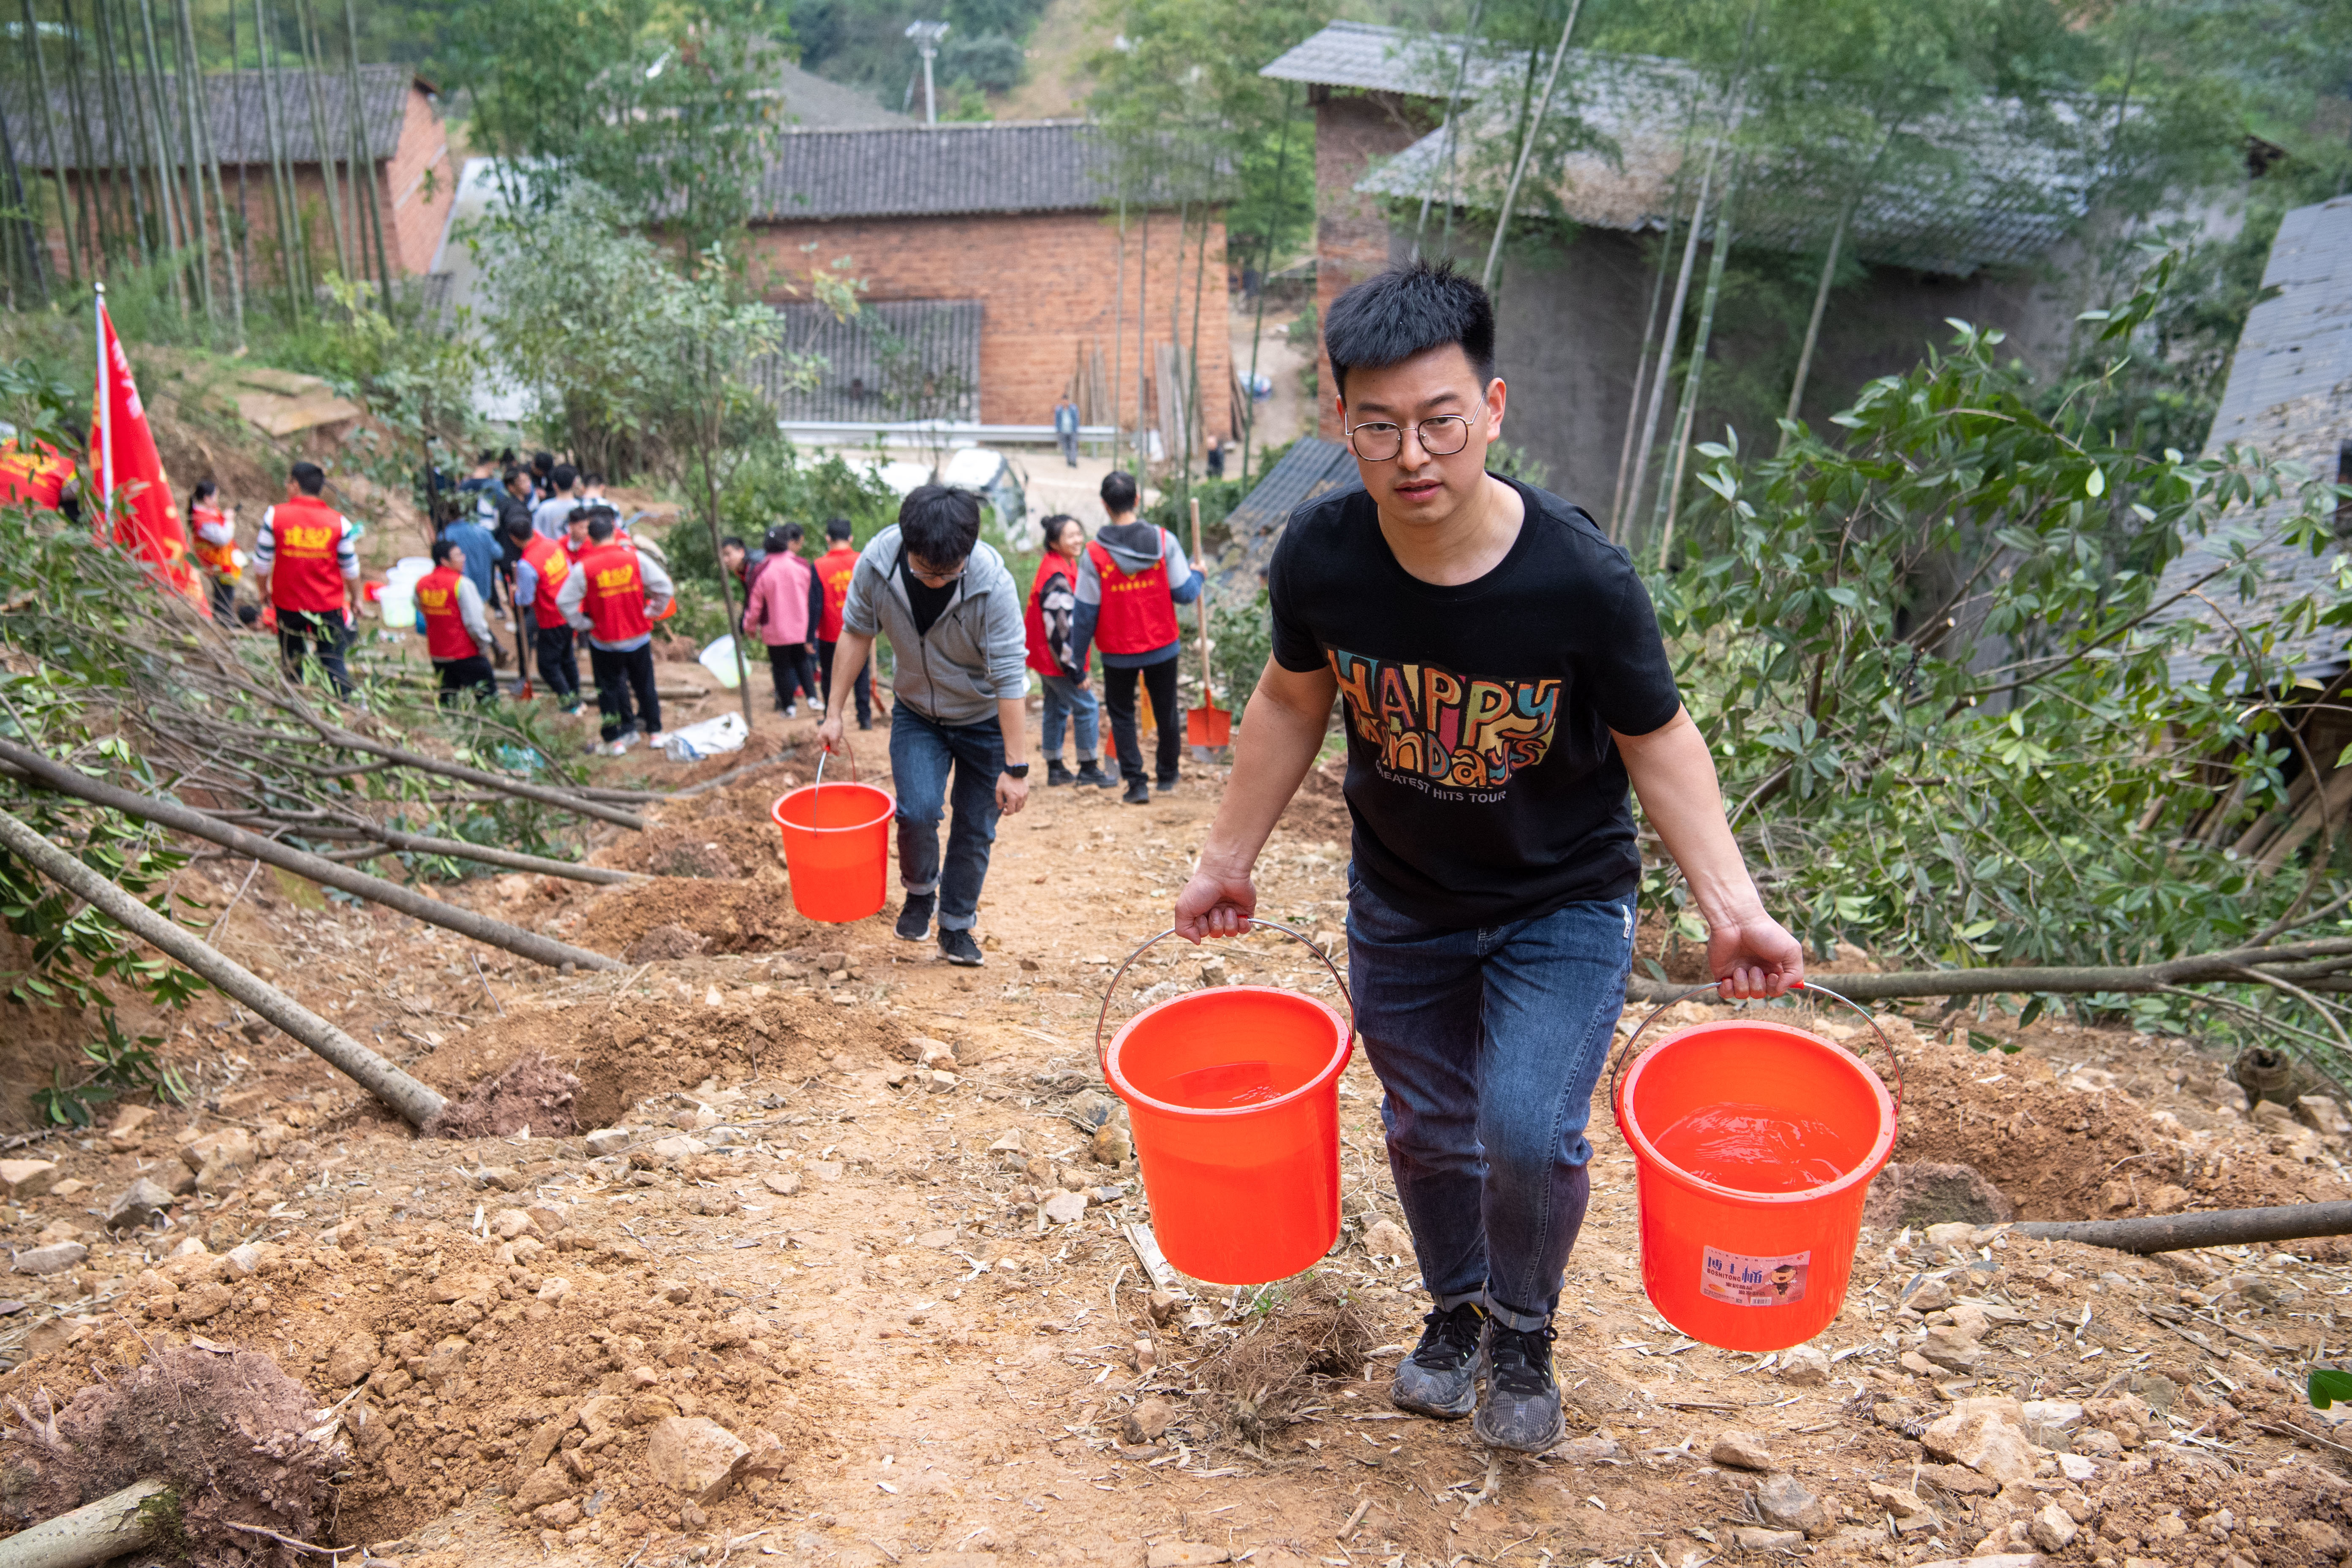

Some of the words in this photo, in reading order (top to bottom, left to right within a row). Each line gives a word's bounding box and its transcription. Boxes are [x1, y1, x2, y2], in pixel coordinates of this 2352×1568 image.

[1433, 788, 1464, 801] HITS
[1468, 790, 1506, 803] TOUR
[1707, 1269, 1741, 1282] BOSHITONG
